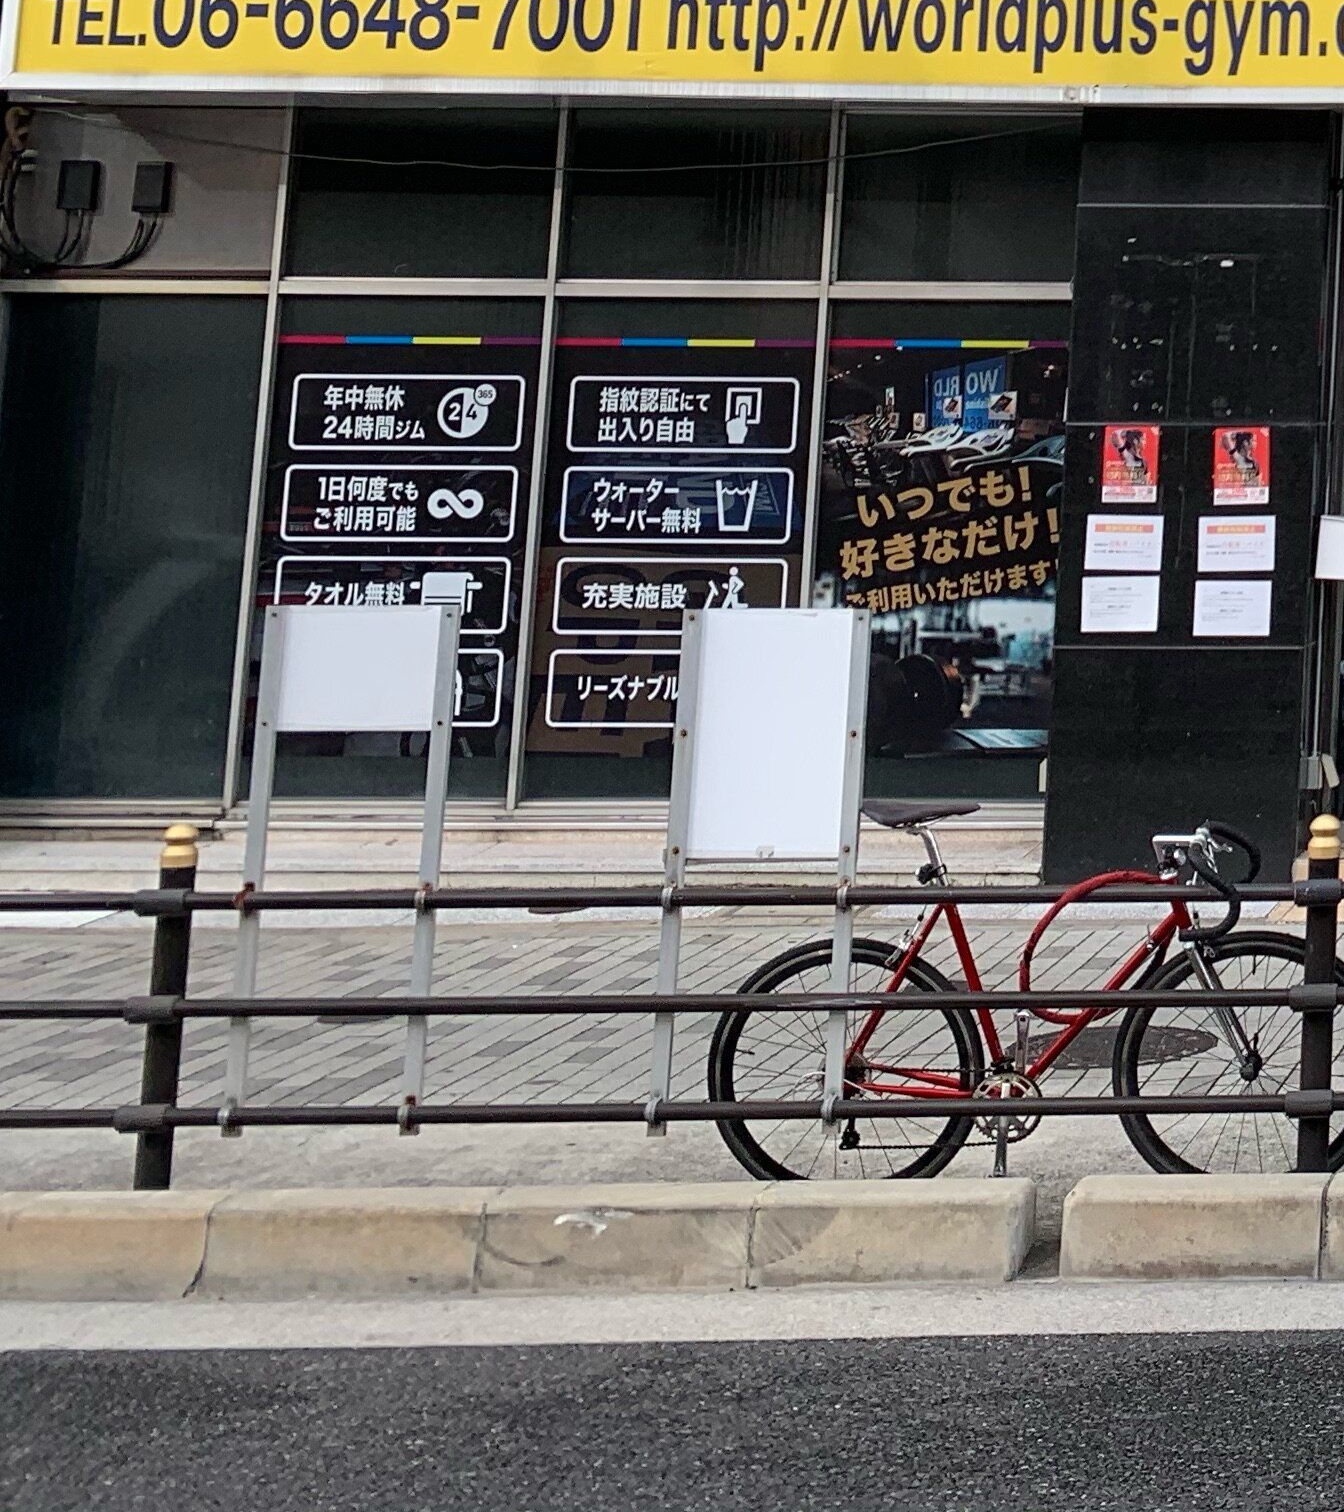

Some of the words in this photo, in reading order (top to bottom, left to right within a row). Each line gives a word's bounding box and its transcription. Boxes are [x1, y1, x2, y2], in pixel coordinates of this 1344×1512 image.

[322, 384, 405, 411] 年中無休
[598, 386, 711, 414] 指紋認証にて
[322, 415, 426, 441] 24時間ジム
[597, 417, 695, 444] 出入り自由
[317, 476, 420, 502] 1日何度でも
[592, 477, 681, 502] ウォーター
[856, 465, 1033, 529] いつでも!
[313, 506, 417, 533] ご利用可能
[591, 508, 702, 535] サーバー無料
[839, 507, 1061, 581] 好きなだけ!
[304, 580, 406, 606] タオル無料
[582, 582, 688, 610] 充実施設
[577, 675, 680, 702] リーズナブル
